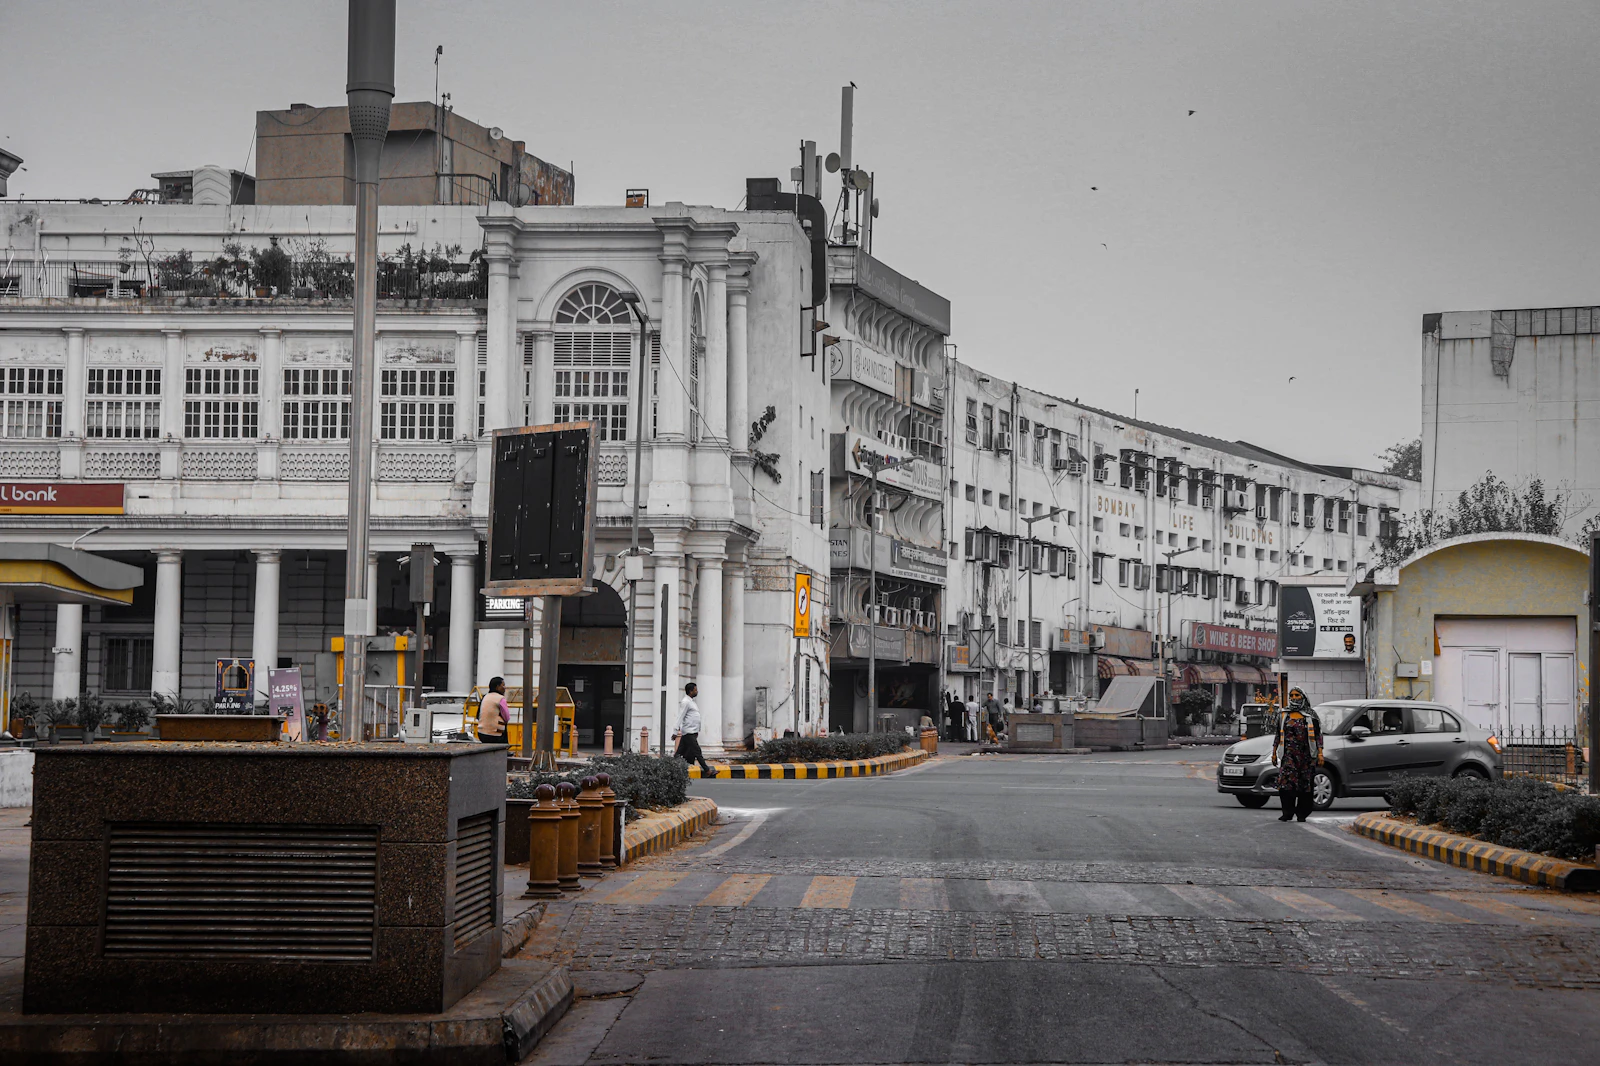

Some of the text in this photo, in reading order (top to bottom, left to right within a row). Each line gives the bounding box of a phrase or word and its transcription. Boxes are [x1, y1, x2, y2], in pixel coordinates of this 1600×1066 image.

[12, 486, 57, 501] bank
[1097, 495, 1273, 545] BOMBAY LIFE BUILDING
[490, 598, 521, 609] PARKING
[1209, 630, 1229, 647] WINE
[1230, 633, 1236, 648] &
[1237, 634, 1256, 650] BEER
[1257, 637, 1276, 653] SHOP
[275, 684, 298, 693] 4.25%
